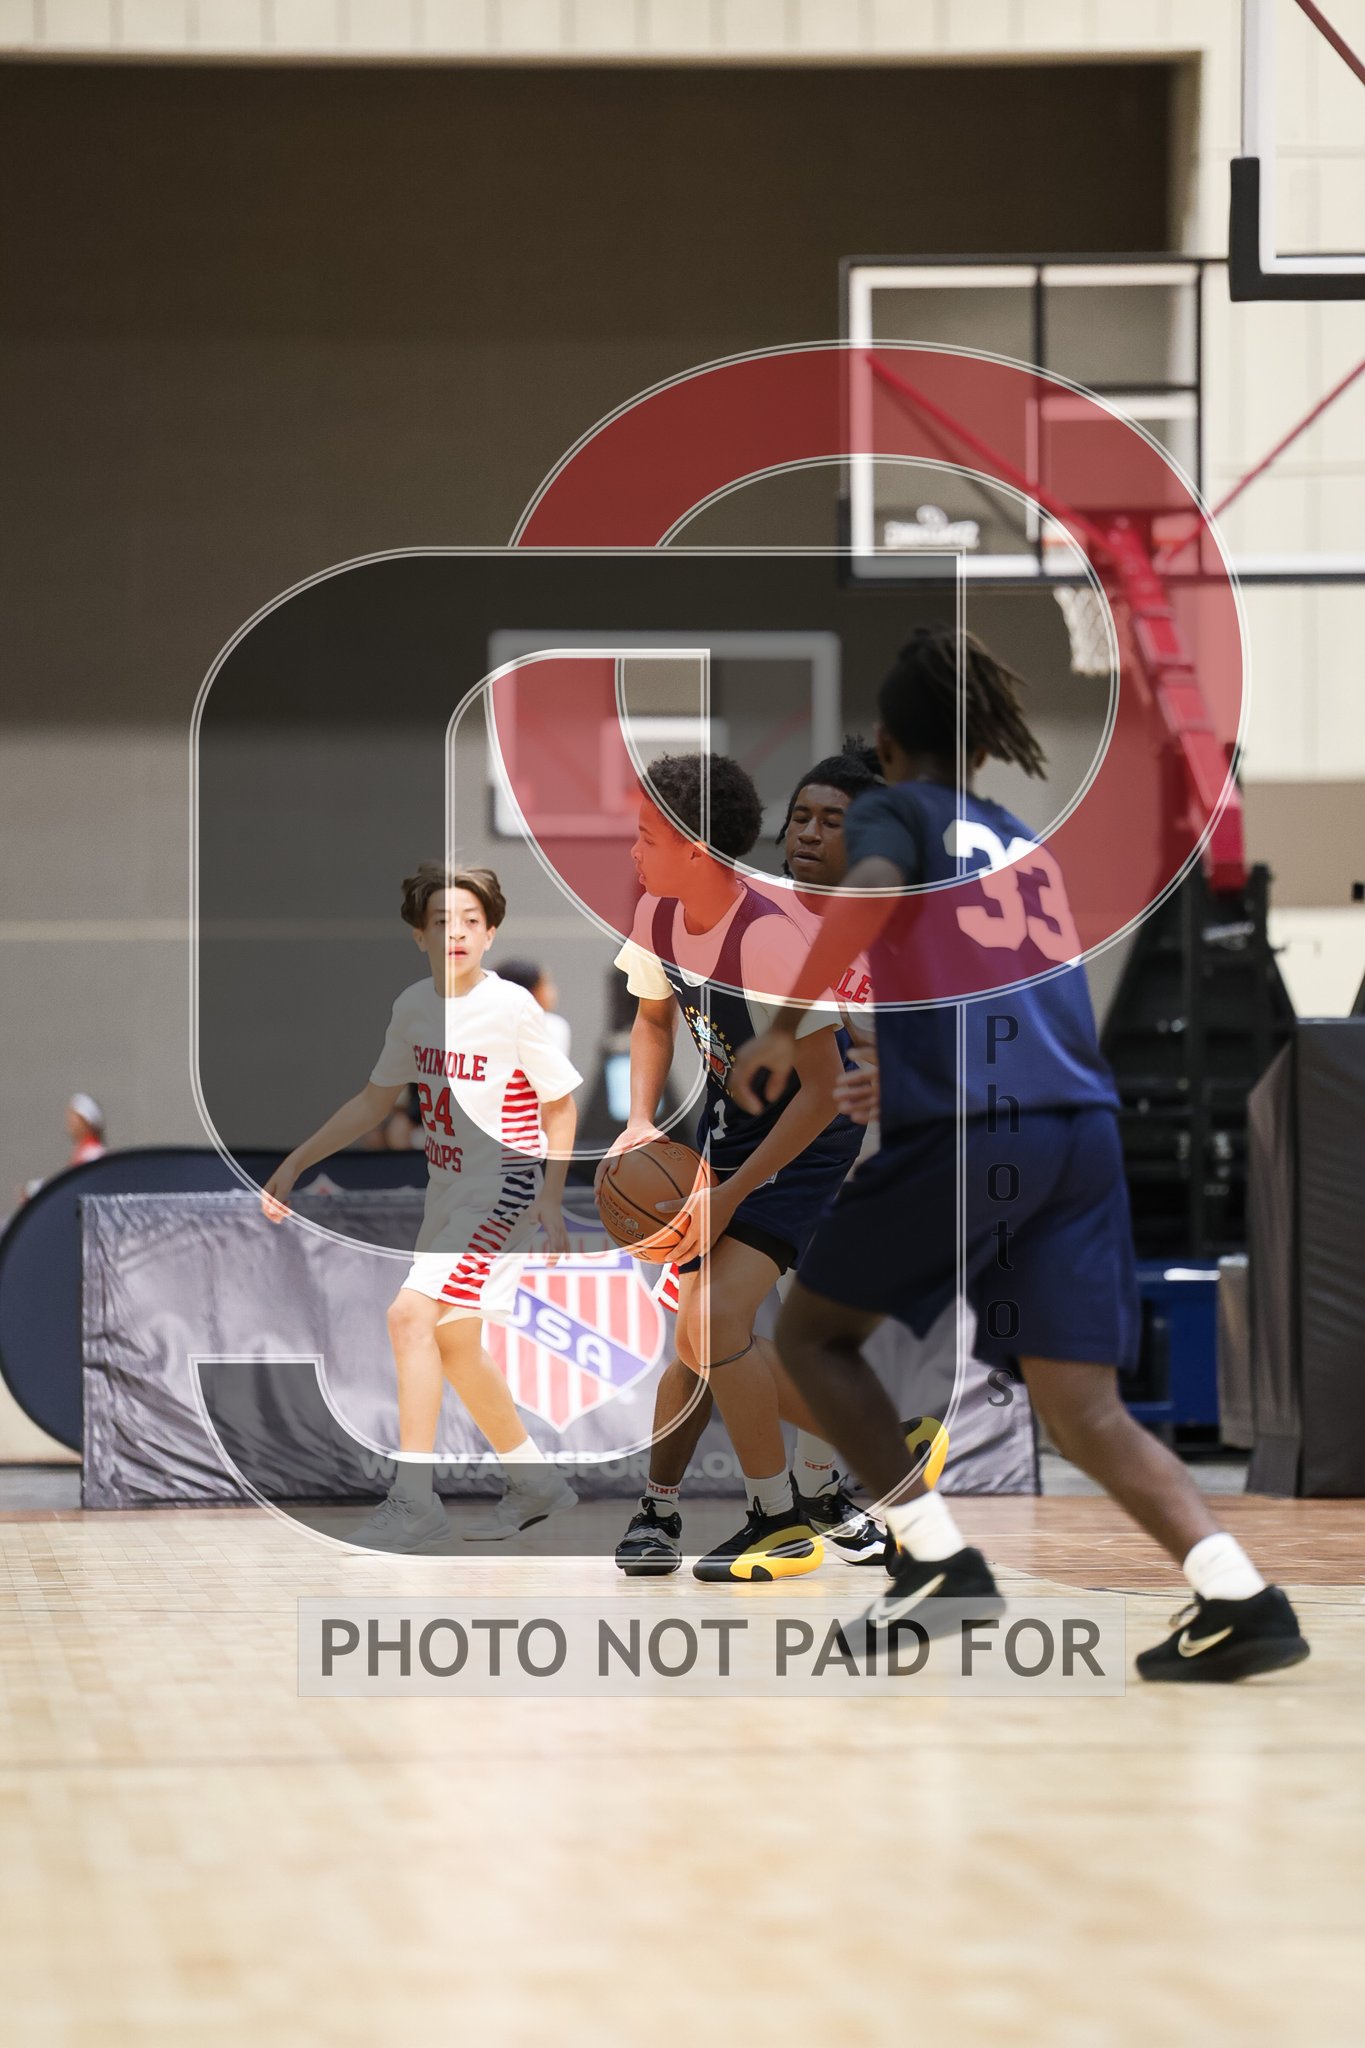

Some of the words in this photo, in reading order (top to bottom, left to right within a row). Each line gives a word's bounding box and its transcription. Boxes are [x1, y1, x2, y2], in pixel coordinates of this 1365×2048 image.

[942, 819, 1083, 968] 33
[834, 967, 873, 1004] LE
[417, 1082, 456, 1137] 24
